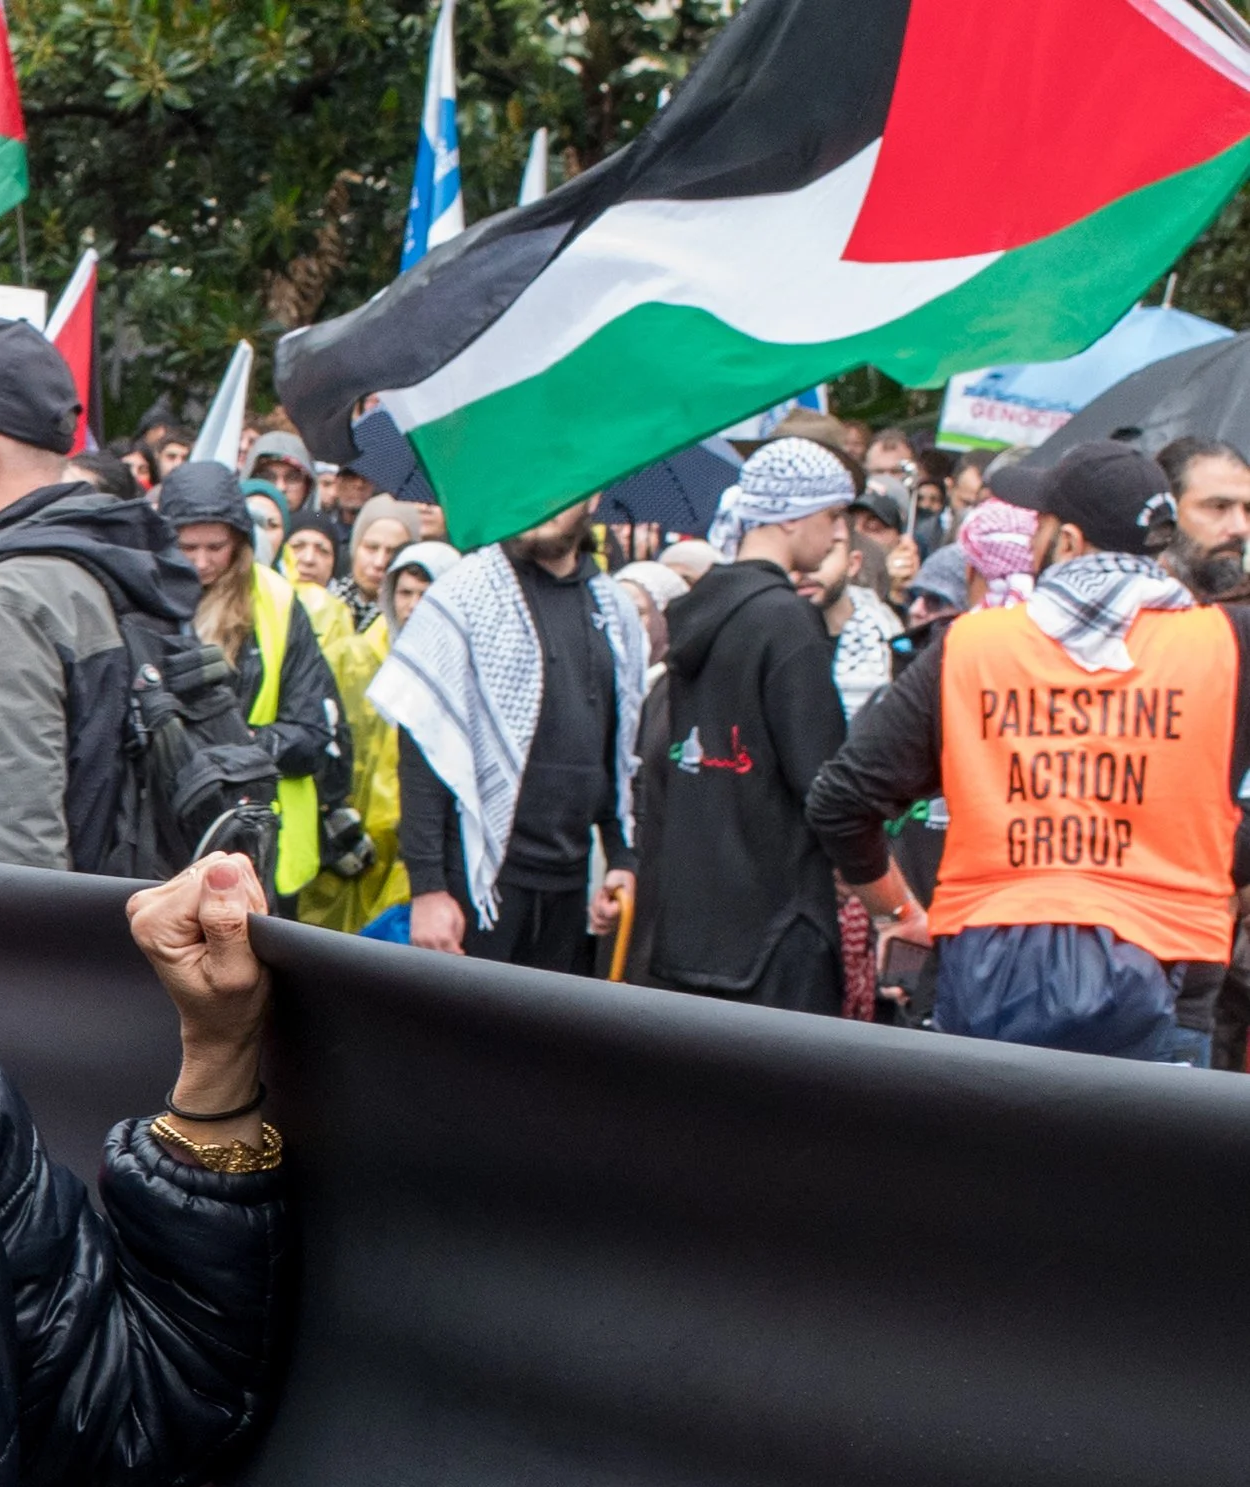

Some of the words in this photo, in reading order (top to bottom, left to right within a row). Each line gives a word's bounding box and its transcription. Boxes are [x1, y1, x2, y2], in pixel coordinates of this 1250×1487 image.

[980, 688, 1184, 740] PALESTINE
[1006, 751, 1147, 806] ACTION
[1007, 815, 1132, 868] GROUP
